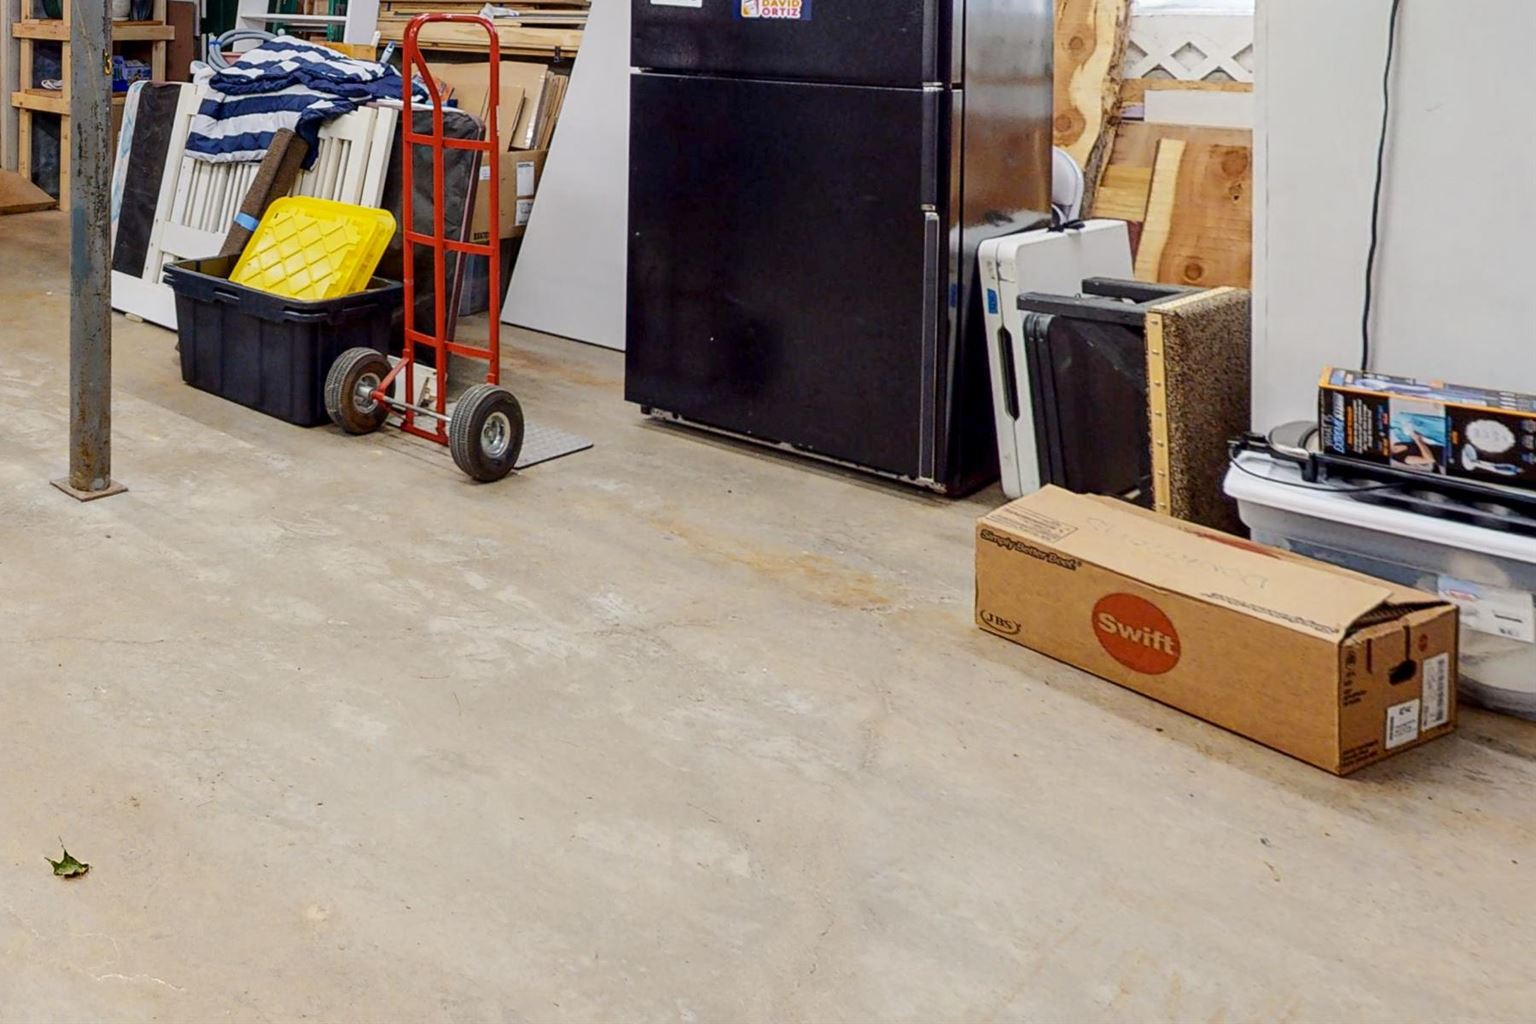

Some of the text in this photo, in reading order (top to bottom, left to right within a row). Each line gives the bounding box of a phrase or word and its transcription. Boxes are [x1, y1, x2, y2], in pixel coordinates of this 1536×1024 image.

[762, 7, 799, 17] ORTIZ
[986, 612, 1013, 630] JBS
[1098, 612, 1175, 656] Swift
